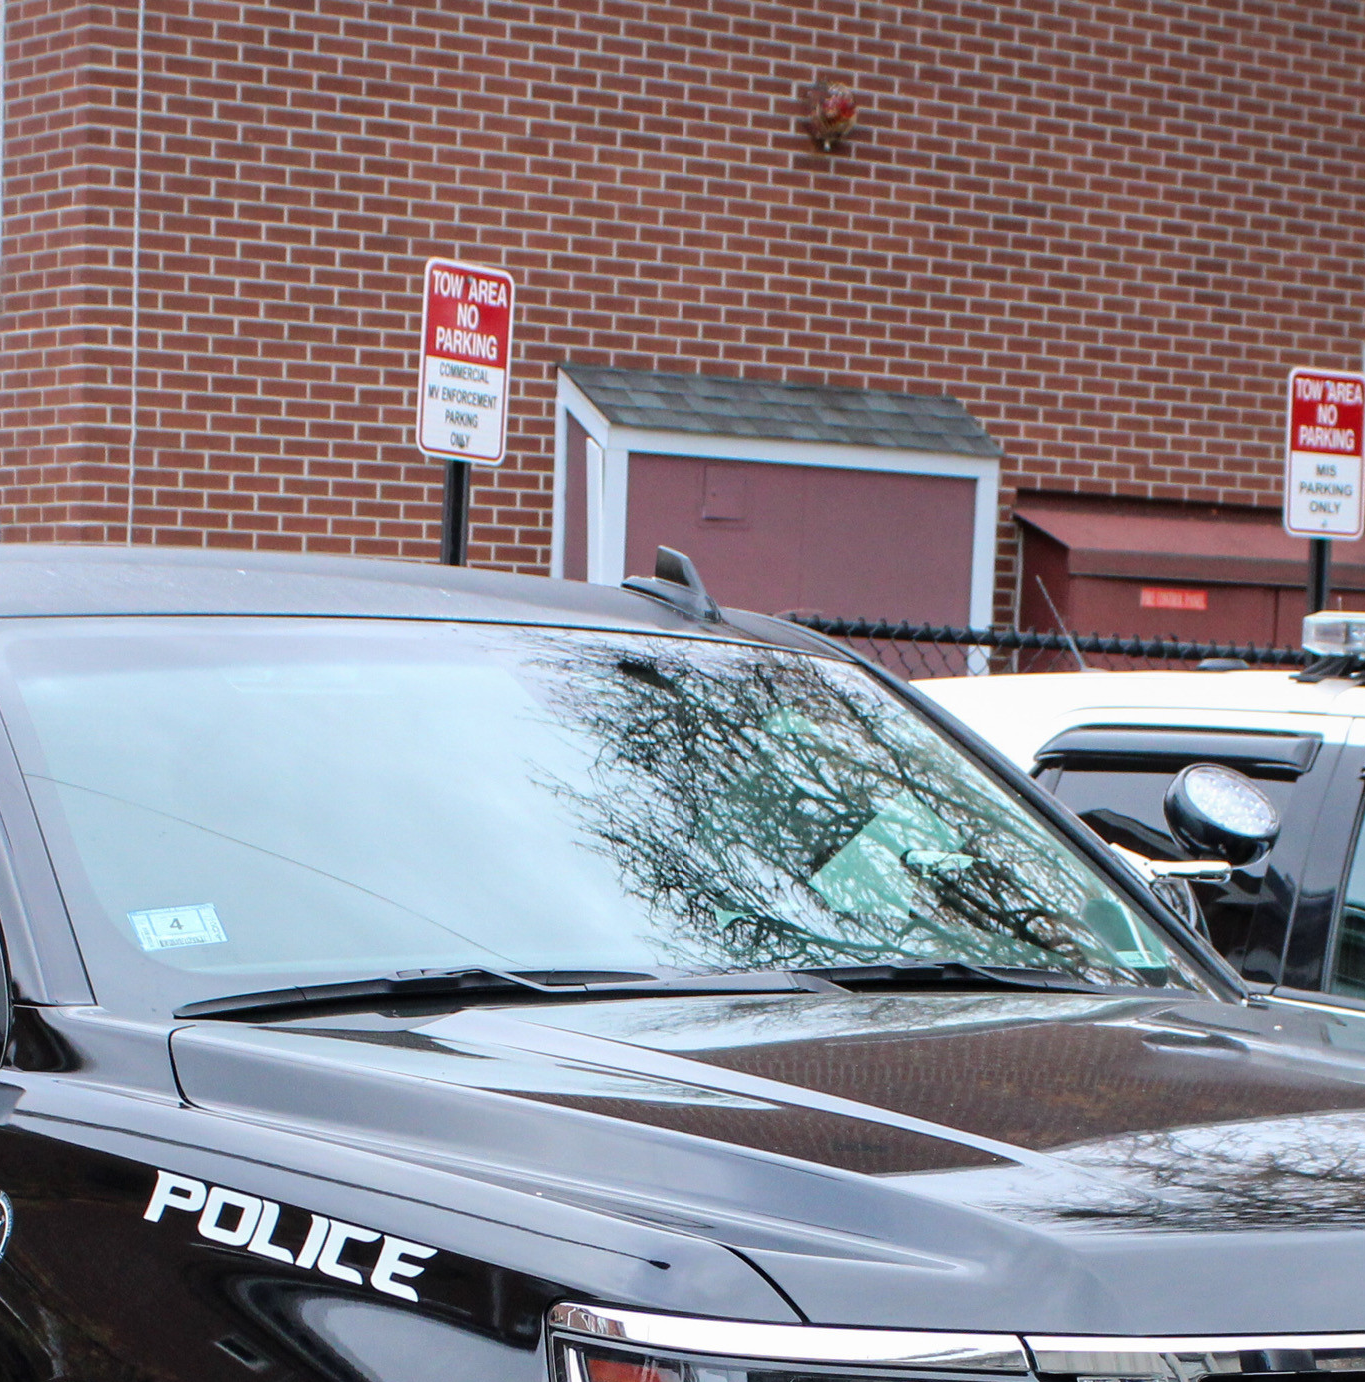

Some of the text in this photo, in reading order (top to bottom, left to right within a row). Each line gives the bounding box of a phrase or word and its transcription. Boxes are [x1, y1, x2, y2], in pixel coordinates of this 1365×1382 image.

[433, 270, 507, 308] TOW AREA
[457, 303, 479, 329] NO
[436, 327, 498, 360] PARKING
[440, 362, 489, 384] COMMERCIAL
[442, 387, 498, 409] ENFORCEMENT
[1295, 378, 1363, 404] TOW AREA
[445, 409, 478, 428] PARKING
[1317, 404, 1338, 426] NO
[1298, 426, 1355, 450] PARKING
[1316, 464, 1336, 478] MIS
[1299, 481, 1353, 496] PARKING
[1310, 501, 1341, 514] ONLY
[170, 918, 184, 930] 4
[143, 1169, 438, 1303] POLICE
